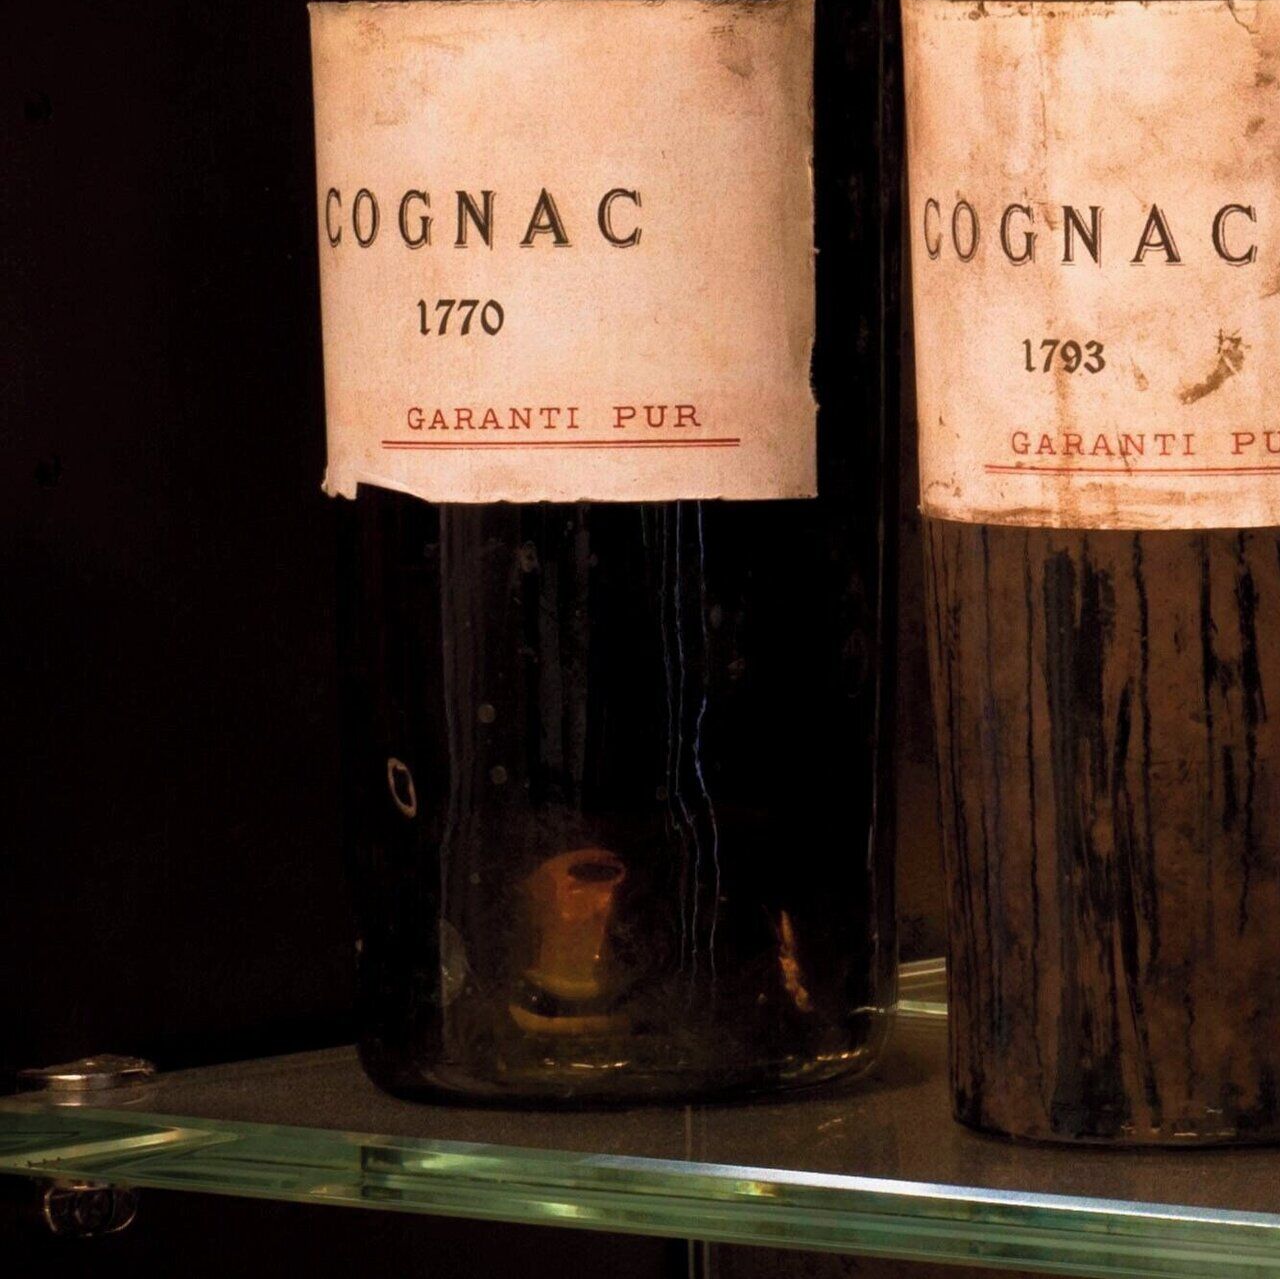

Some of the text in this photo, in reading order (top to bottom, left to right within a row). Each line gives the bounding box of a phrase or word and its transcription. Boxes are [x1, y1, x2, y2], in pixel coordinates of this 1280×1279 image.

[326, 188, 642, 250] COGNAC
[923, 197, 1257, 267] COGNAC
[417, 299, 505, 336] 1770
[1022, 338, 1106, 374] 1793
[407, 404, 702, 431] GARANTI PUR
[1012, 431, 1195, 457] GARANTI
